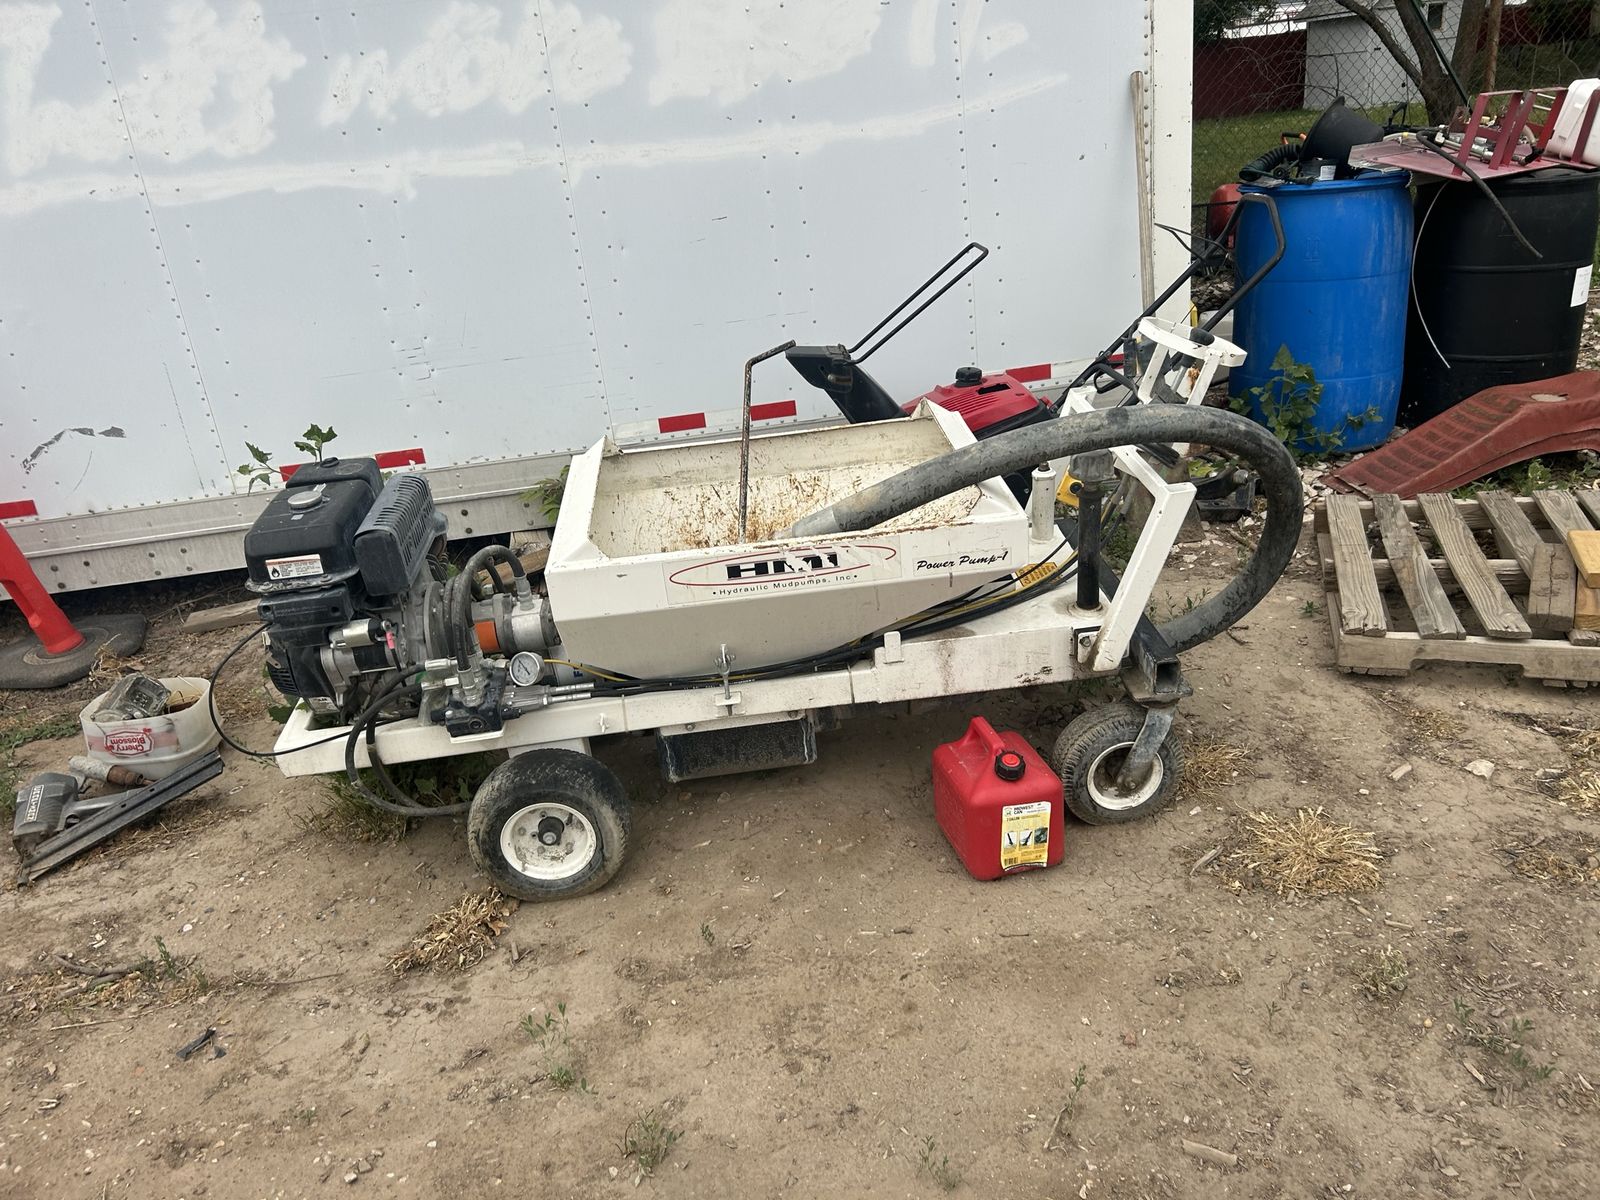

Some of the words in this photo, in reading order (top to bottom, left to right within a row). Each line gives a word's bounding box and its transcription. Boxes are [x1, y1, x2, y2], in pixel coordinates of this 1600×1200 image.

[916, 560, 955, 571] Power
[958, 551, 1009, 566] Pump-1
[719, 584, 769, 597] Hydraulic
[110, 737, 146, 745] Blossom
[116, 744, 145, 752] Cherry
